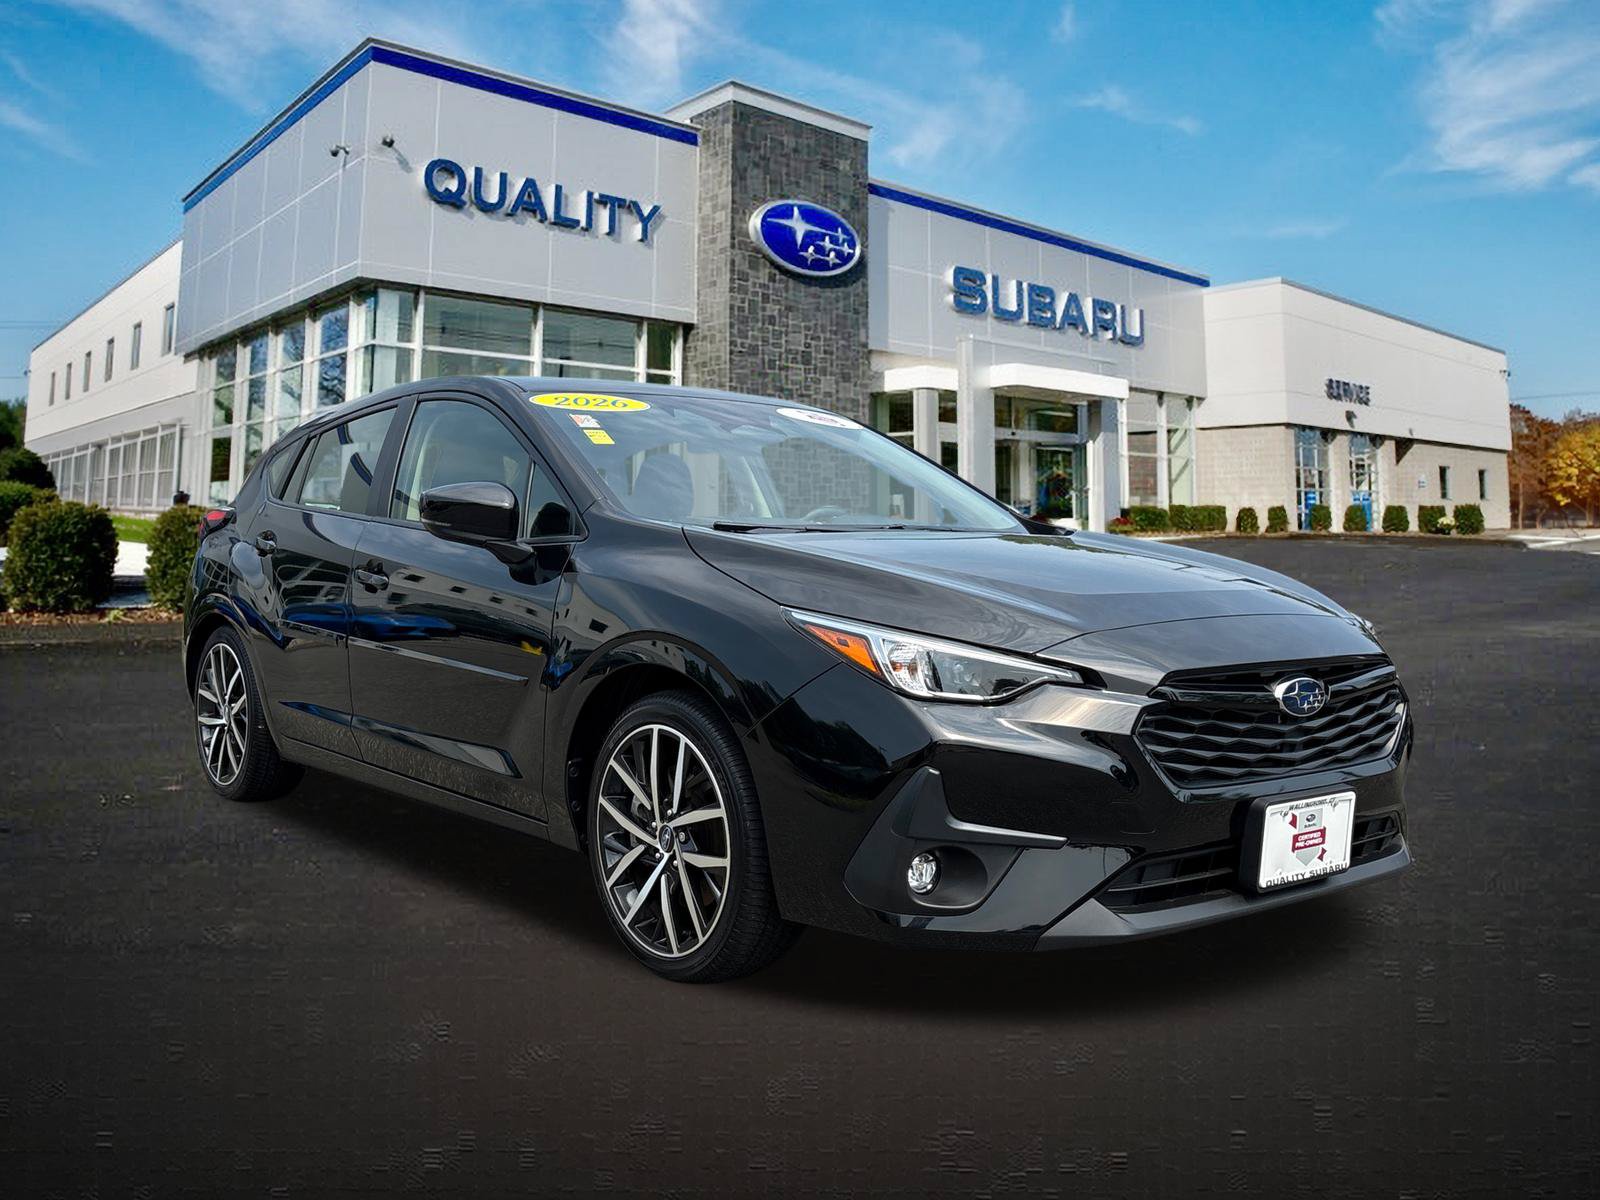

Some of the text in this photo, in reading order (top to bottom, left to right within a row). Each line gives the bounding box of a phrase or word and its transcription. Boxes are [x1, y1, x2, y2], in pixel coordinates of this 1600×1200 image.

[424, 158, 661, 242] QUALITY
[952, 266, 1144, 346] SUBARU
[554, 397, 628, 408] 2026
[1295, 838, 1322, 848] PRE-OWNED
[1298, 831, 1321, 841] CERTIFIED
[1265, 862, 1347, 887] QUALITY SUBARU
